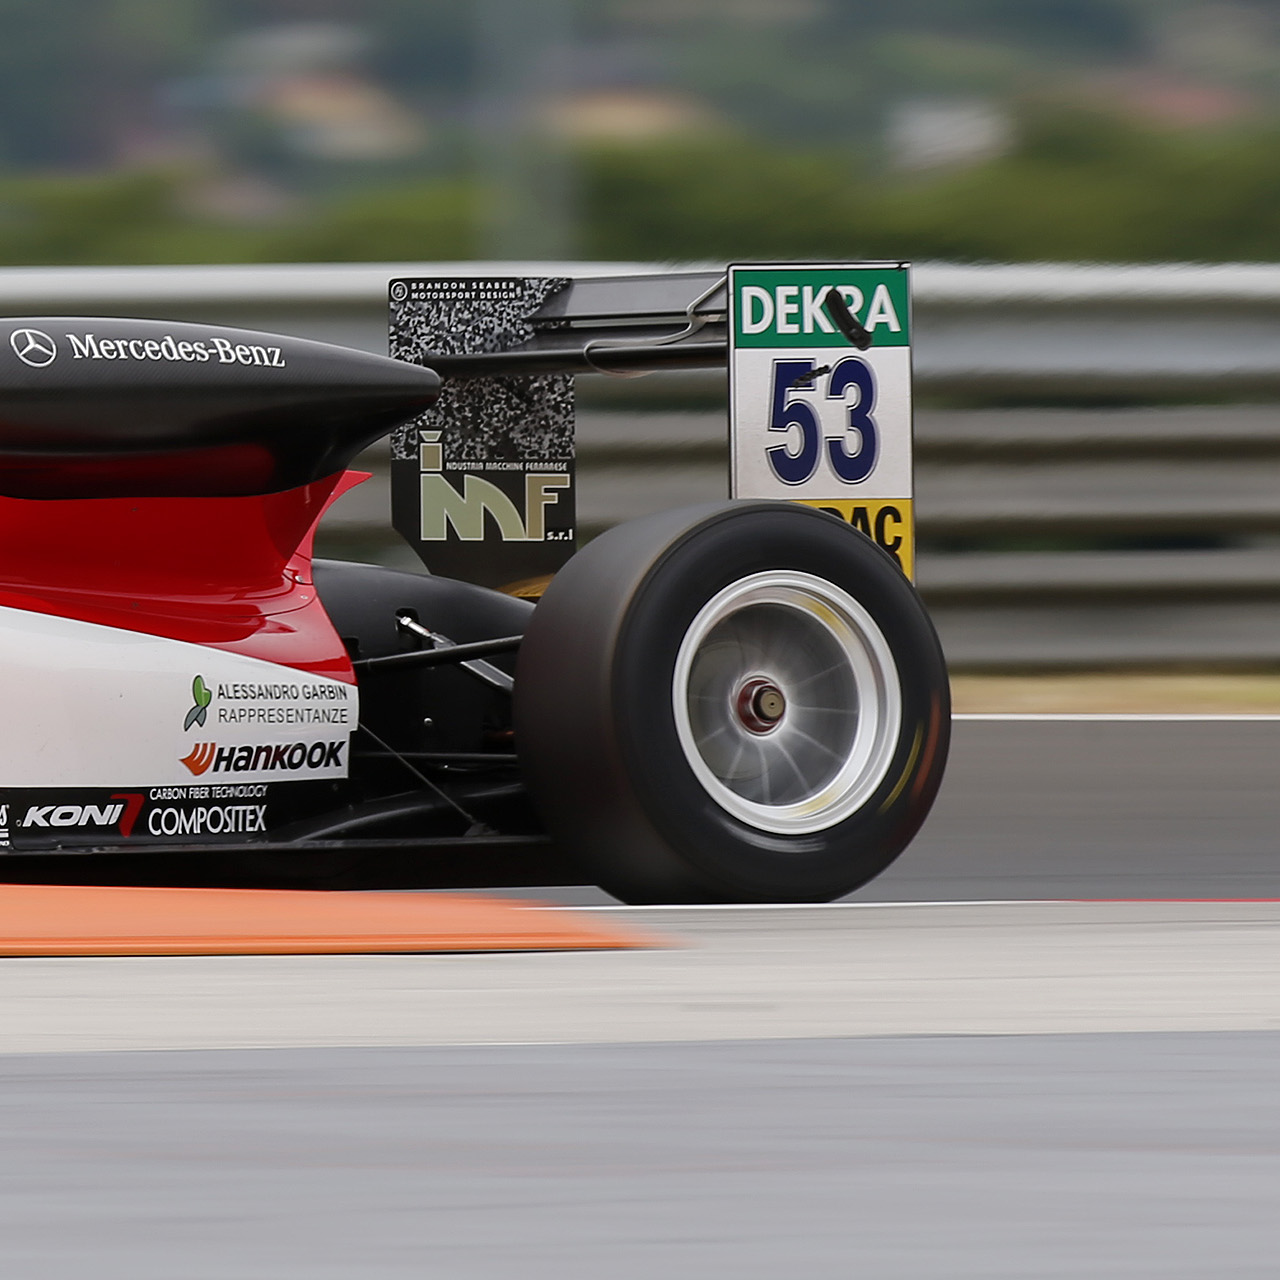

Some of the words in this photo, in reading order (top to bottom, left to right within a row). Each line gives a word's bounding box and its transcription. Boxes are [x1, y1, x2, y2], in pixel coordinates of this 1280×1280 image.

[411, 282, 466, 290] BRANDON
[472, 282, 515, 290] SEABER
[411, 292, 476, 300] MOTORSPORT
[480, 292, 515, 300] DESIGN
[66, 333, 287, 368] Mercedes-Benz
[765, 356, 881, 486] 53
[217, 683, 299, 701] ALESSANDRO
[302, 683, 348, 701] GARBIN
[218, 707, 349, 724] RAPPRESENTANZE
[149, 788, 187, 800] CARBON
[188, 786, 210, 799] FIBER
[211, 784, 268, 799] TECHNOLOGY
[22, 803, 125, 828] KONI
[148, 804, 268, 836] COMPOSITEX
